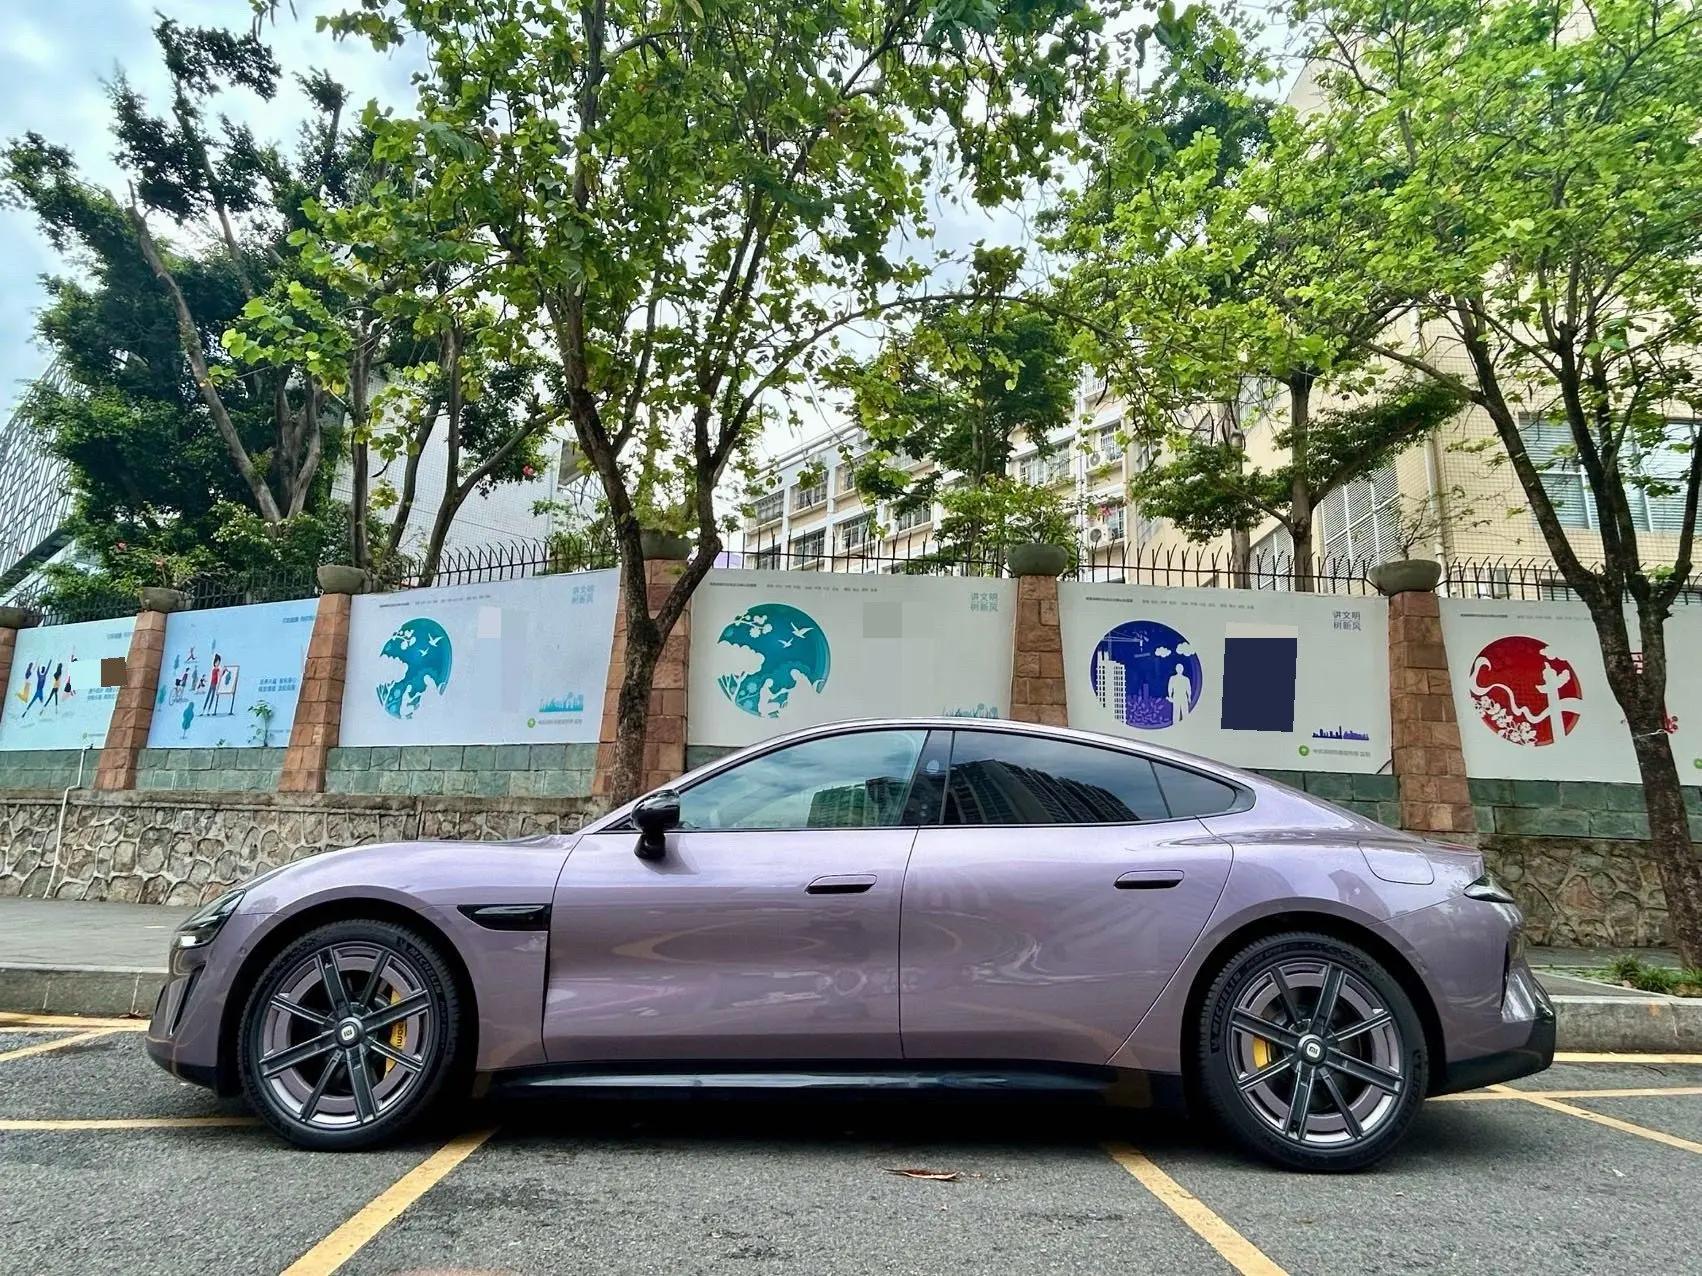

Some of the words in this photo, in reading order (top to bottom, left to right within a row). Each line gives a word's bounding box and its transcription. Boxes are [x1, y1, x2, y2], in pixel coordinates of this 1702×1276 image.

[1332, 610, 1361, 620] 讲文明
[1332, 620, 1361, 631] 树新风
